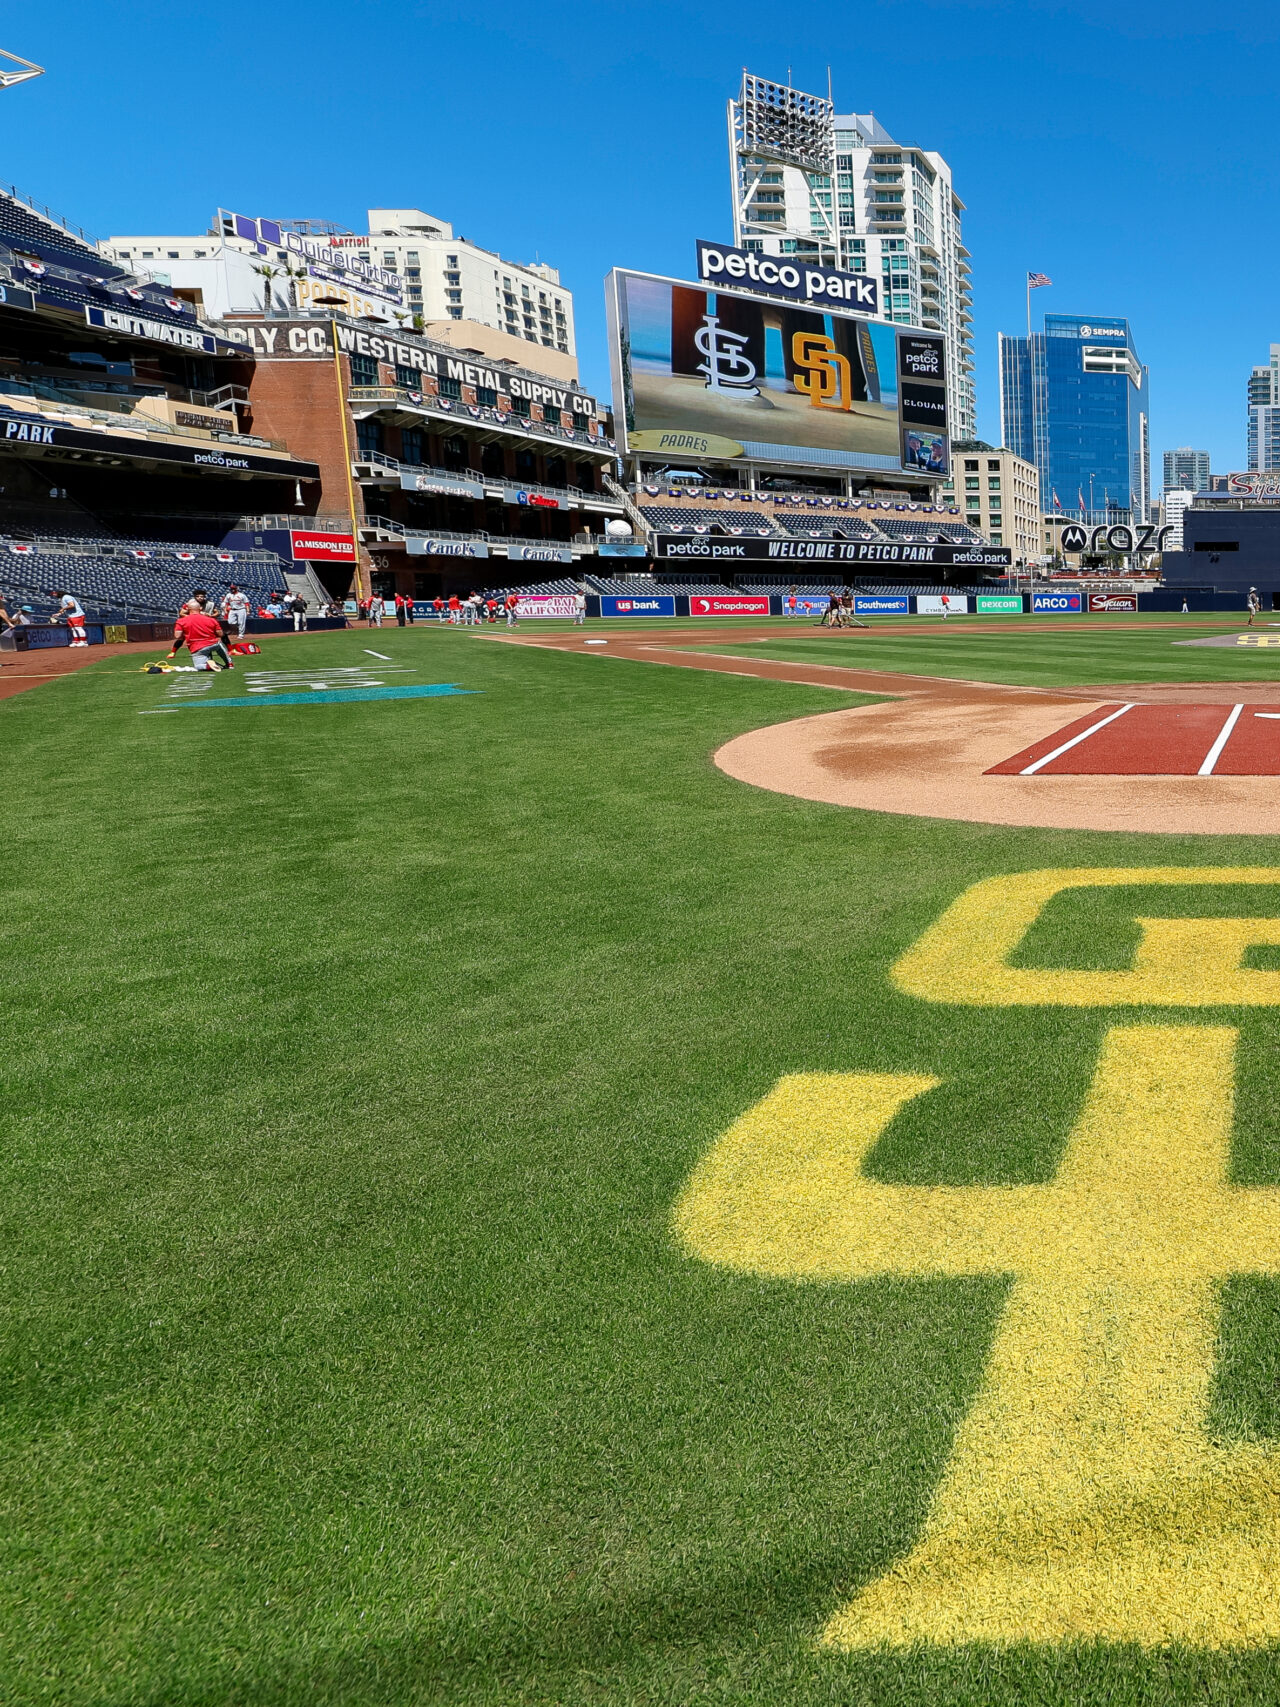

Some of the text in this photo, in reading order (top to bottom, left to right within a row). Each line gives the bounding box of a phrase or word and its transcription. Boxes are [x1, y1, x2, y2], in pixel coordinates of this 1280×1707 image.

[328, 236, 370, 248] Marriott
[286, 232, 403, 290] QuidelOrtho
[701, 247, 875, 305] petco park
[104, 311, 205, 350] CUTWATER
[1092, 328, 1125, 337] SEMPRA
[861, 330, 877, 374] PADRES
[906, 354, 939, 364] petco
[336, 326, 596, 417] WESTERN METAL SUPPLY CO.
[912, 363, 939, 373] park
[903, 399, 945, 411] ELOUAN
[5, 421, 56, 444] PARK
[659, 434, 708, 453] PADRES
[194, 453, 249, 469] petco park
[1091, 524, 1175, 552] razr
[304, 540, 338, 550] MISSION
[338, 542, 353, 551] FED
[667, 541, 1008, 564] petco park WELCOME TO PETCO PARK petco park
[632, 601, 661, 609] bank
[713, 602, 765, 611] Snapdragon
[857, 600, 900, 609] Southwest
[1034, 598, 1068, 608] ARCO
[1091, 595, 1133, 611] Sycuan
[515, 607, 575, 615] CALIFORNI
